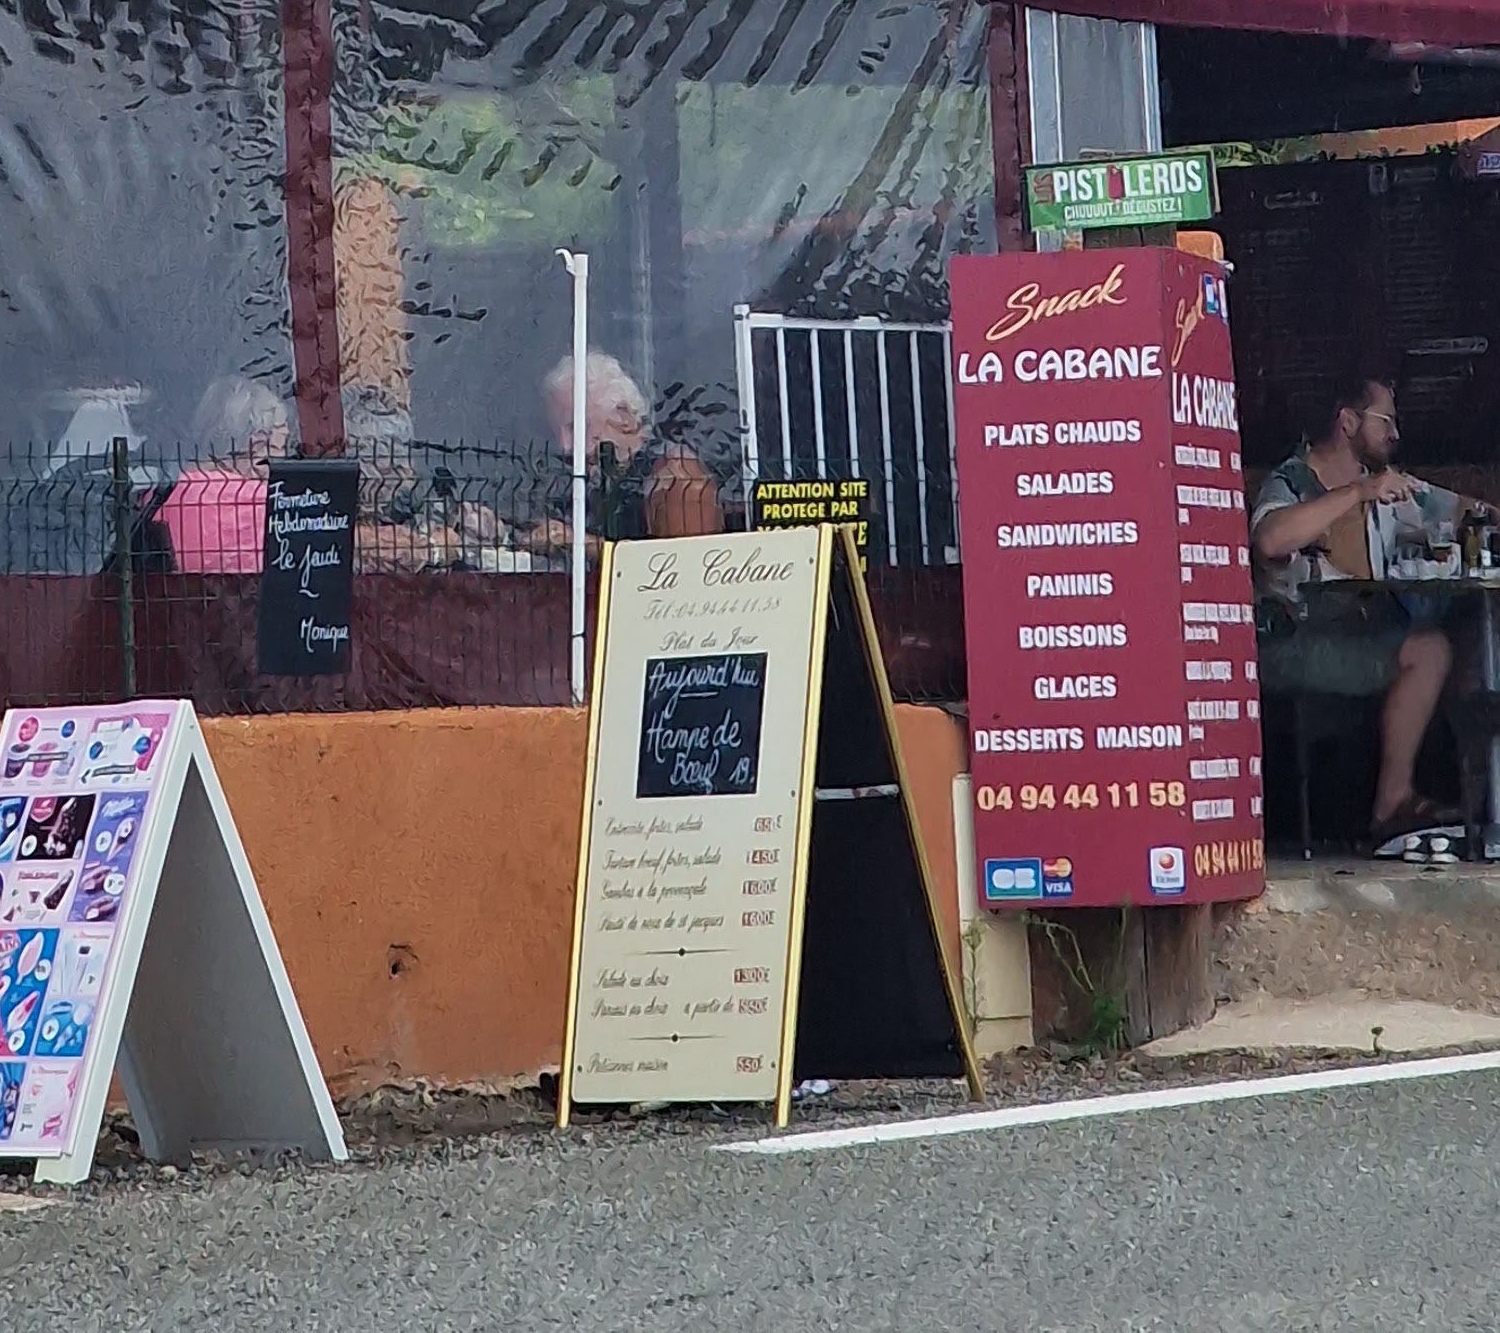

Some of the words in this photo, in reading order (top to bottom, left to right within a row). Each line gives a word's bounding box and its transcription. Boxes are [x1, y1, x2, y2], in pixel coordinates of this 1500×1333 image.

[985, 263, 1128, 341] Snack
[958, 352, 1003, 384] LA
[1014, 345, 1163, 382] CABANE
[1171, 371, 1192, 424] LA
[1193, 374, 1239, 432] CABANE
[984, 422, 1050, 447] PLATS
[1054, 420, 1141, 445] CHAUDS
[268, 480, 331, 511] Fermeture
[756, 482, 835, 500] ATTENTION
[840, 481, 868, 497] SITE
[1017, 471, 1114, 496] SALADES
[763, 502, 826, 519] PROTEGE
[830, 500, 859, 517] PAR
[268, 510, 349, 543] Hebdomadaire
[997, 521, 1139, 547] SANDWICHES
[636, 552, 679, 593] La
[702, 546, 795, 587] Cabane
[1027, 572, 1114, 598] PANINIS
[300, 616, 349, 653] Monique
[660, 630, 695, 652] Plat
[722, 626, 759, 652] Jour
[1019, 623, 1127, 649] BOISSONS
[1034, 675, 1118, 700] GLACES
[647, 709, 711, 764] Hampe
[712, 708, 742, 748] de
[974, 727, 1084, 752] DESSERTS
[1096, 724, 1182, 749] MAISON
[977, 785, 1014, 811] 04
[1019, 783, 1056, 810] 94
[1062, 783, 1100, 809] 44
[1106, 782, 1140, 808] 11
[1148, 780, 1186, 807] 58
[1045, 881, 1072, 893] VISA
